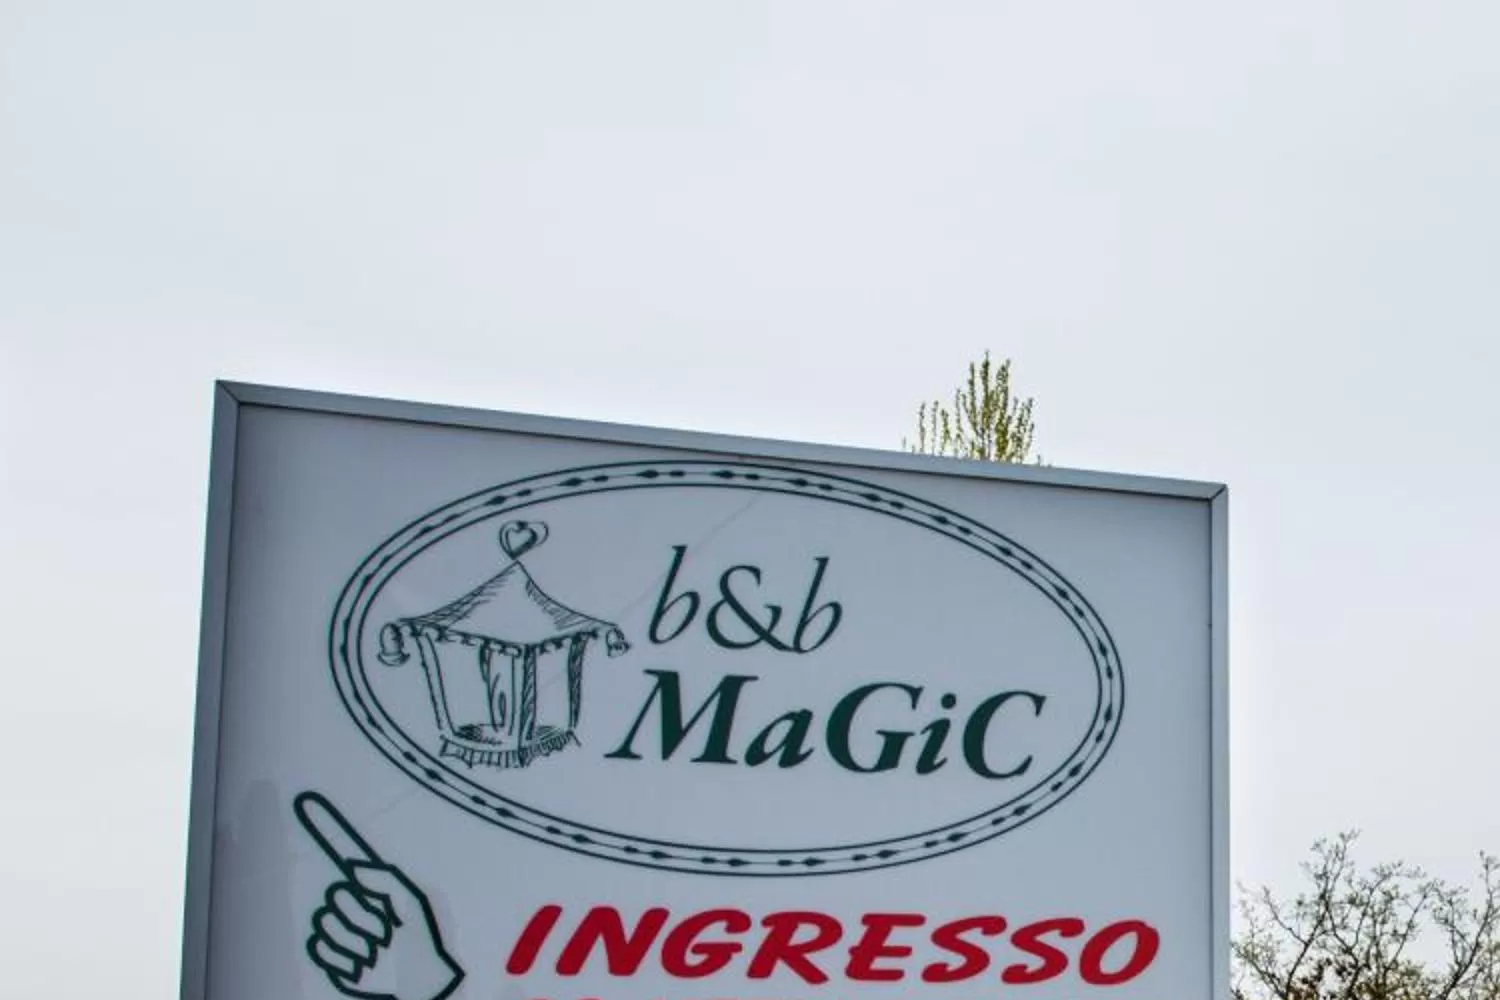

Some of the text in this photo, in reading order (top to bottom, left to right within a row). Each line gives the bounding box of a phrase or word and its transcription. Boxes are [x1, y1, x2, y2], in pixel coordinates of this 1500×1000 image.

[648, 544, 843, 654] b&b
[603, 669, 1047, 780] MaGiC
[506, 904, 1160, 986] INGRESSO
